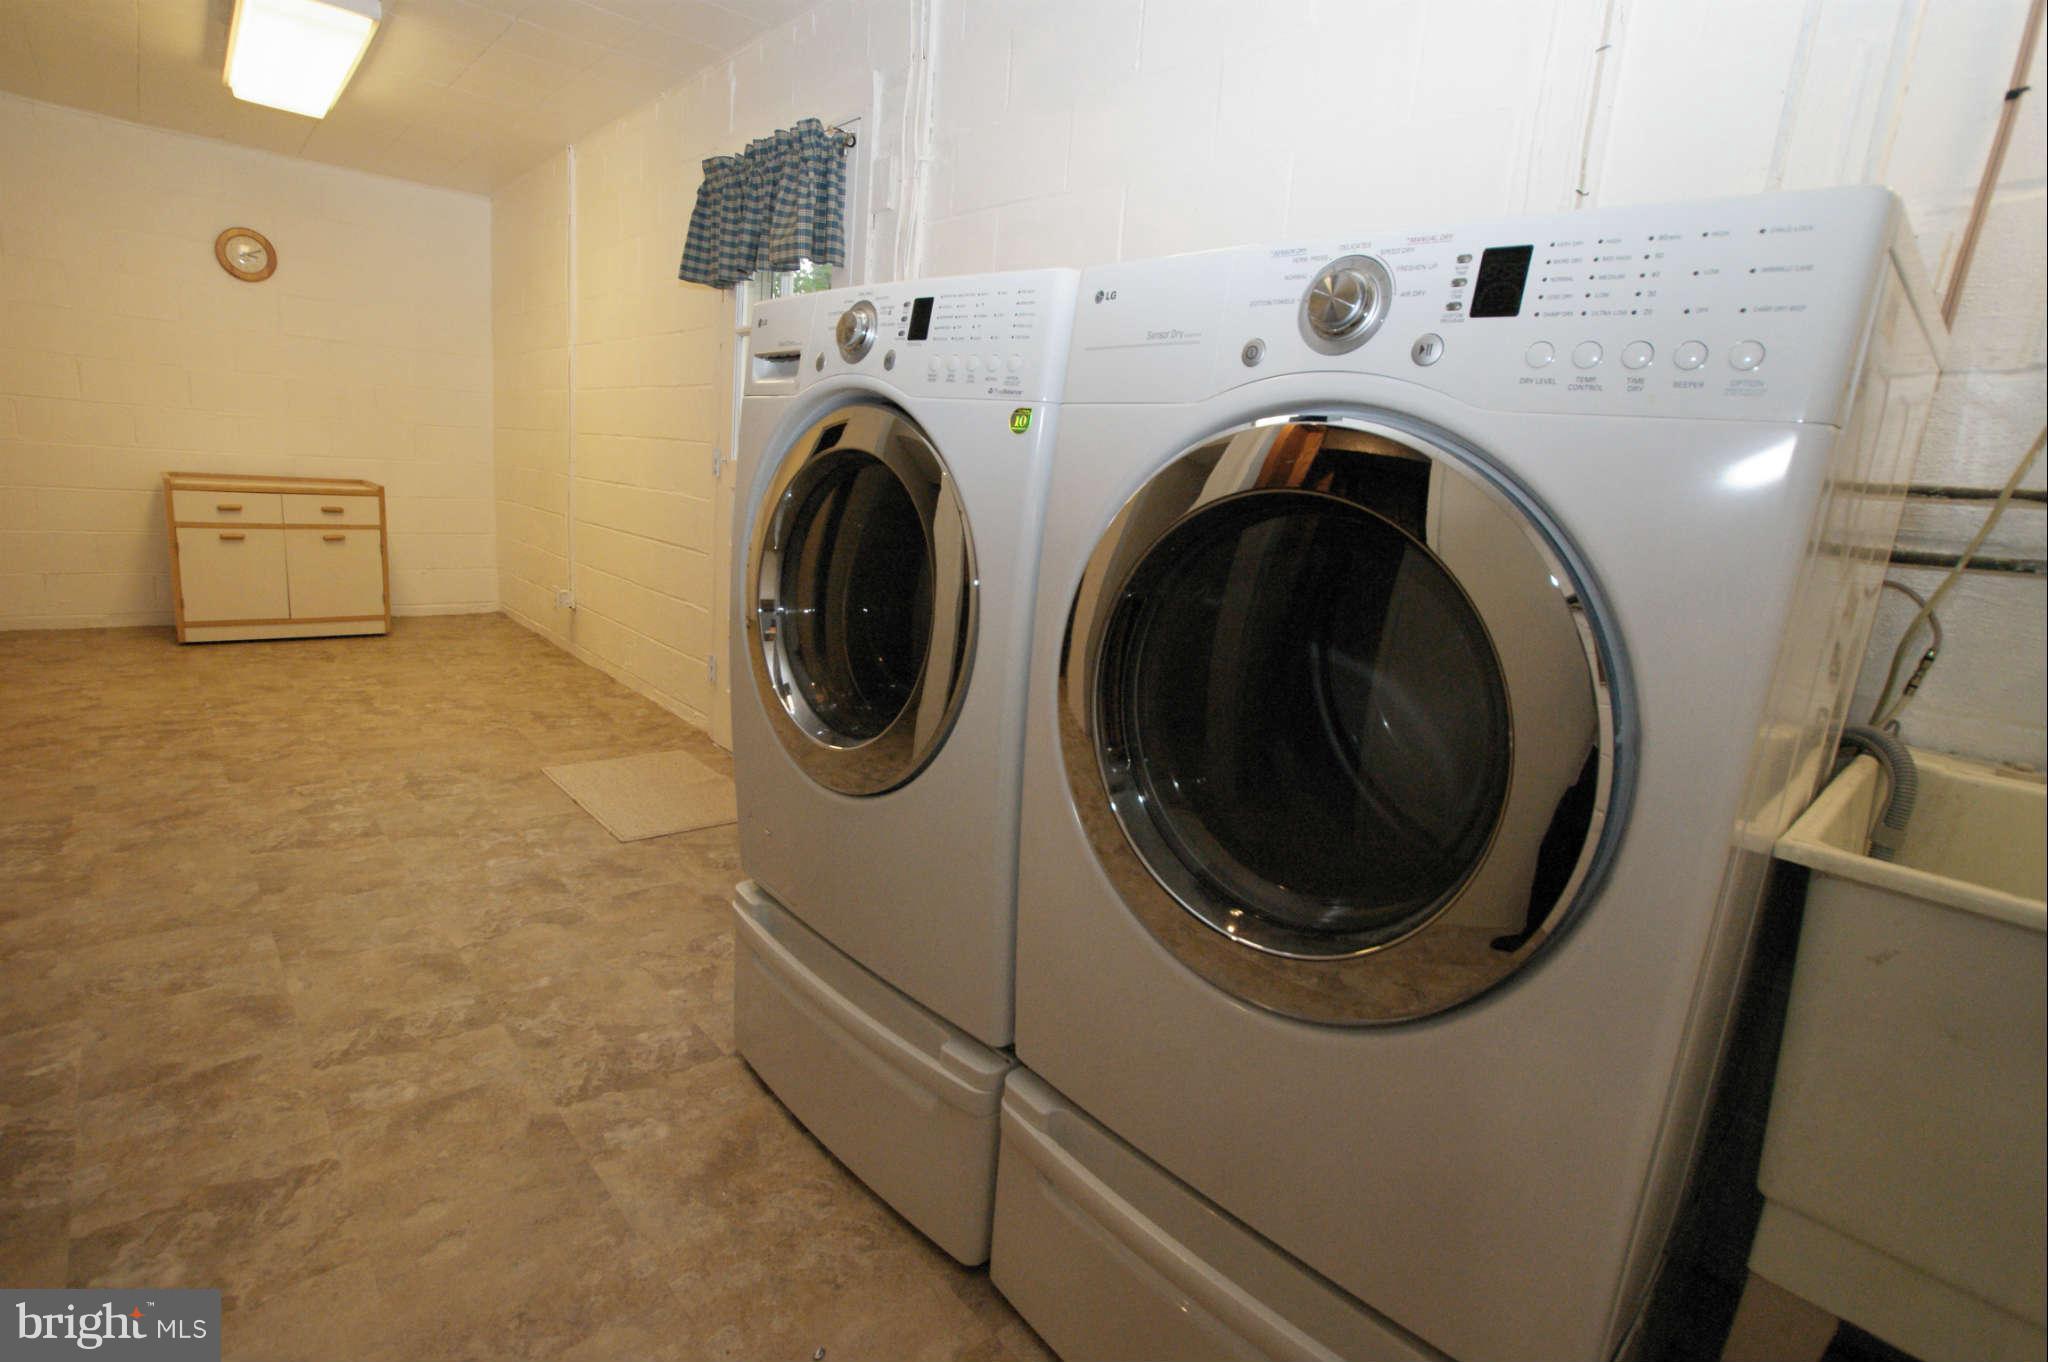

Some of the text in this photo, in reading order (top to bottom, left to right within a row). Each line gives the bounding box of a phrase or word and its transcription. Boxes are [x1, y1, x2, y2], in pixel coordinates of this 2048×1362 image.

[1146, 330, 1170, 341] Sensor
[1171, 328, 1184, 340] Dry
[1519, 377, 1557, 385] DRY LEVEL
[1626, 376, 1645, 384] TIME
[1672, 380, 1705, 389] BEEPER
[1567, 383, 1604, 392] CONTROL
[1626, 384, 1644, 392] DRY
[1013, 414, 1027, 427] 10
